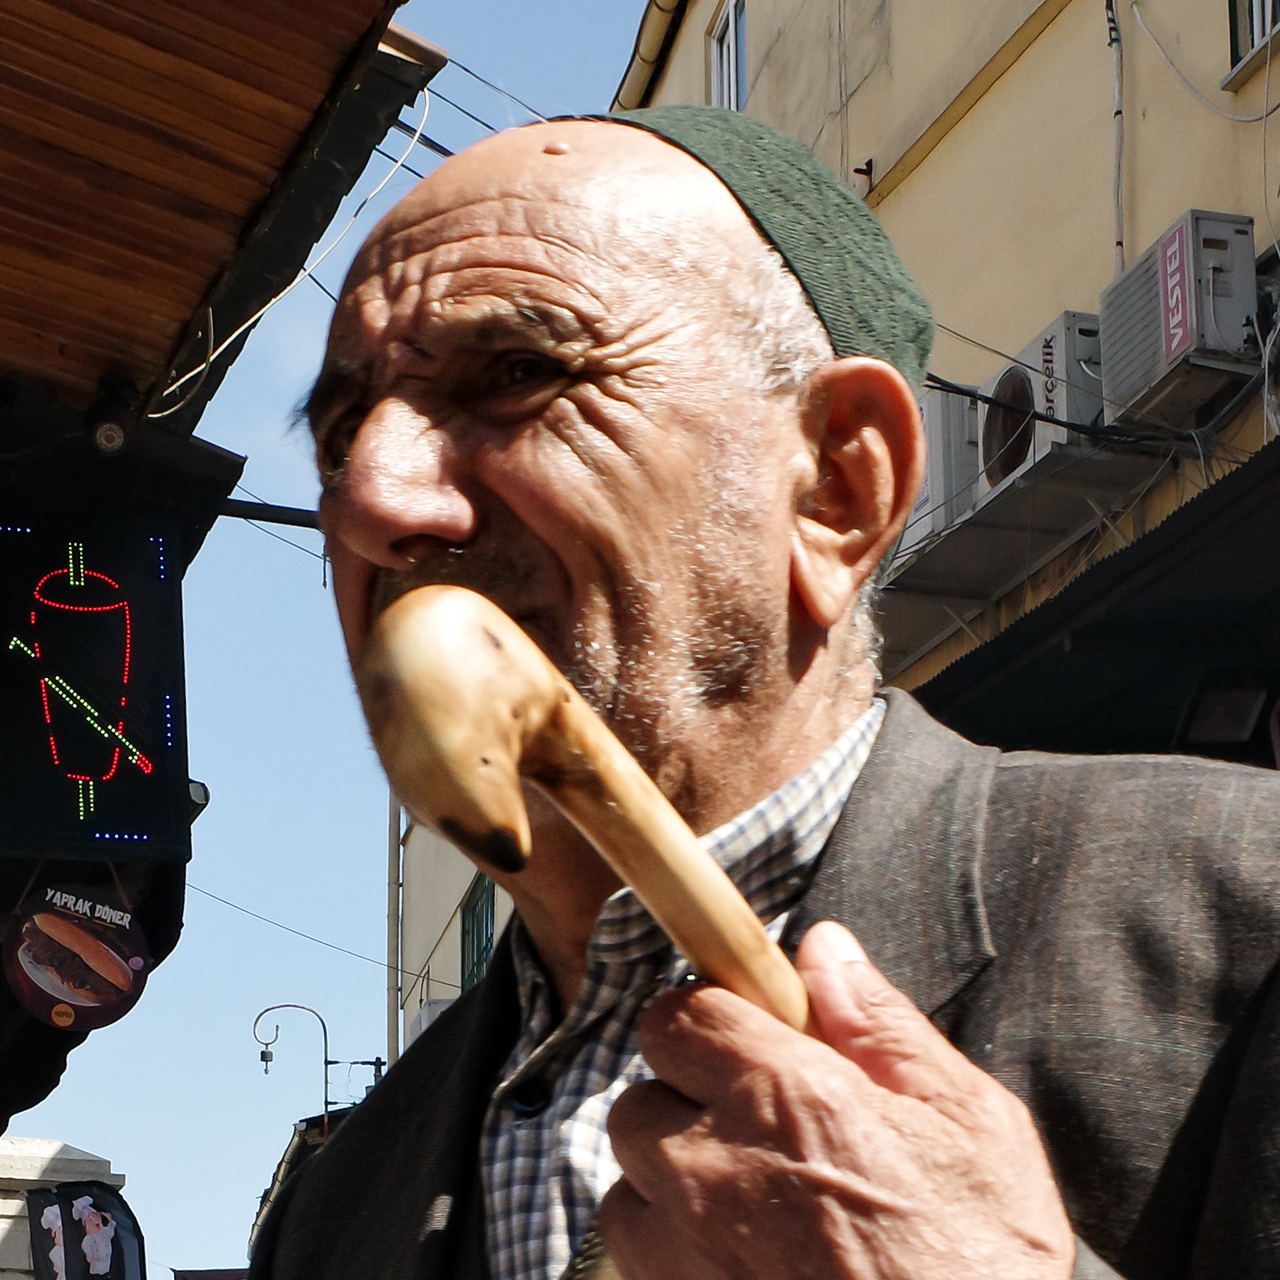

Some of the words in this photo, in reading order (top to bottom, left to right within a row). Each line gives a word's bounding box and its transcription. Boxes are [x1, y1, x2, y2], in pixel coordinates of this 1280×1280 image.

[1165, 231, 1183, 352] VESTEL
[44, 887, 92, 920] YAPRAK
[93, 903, 132, 930] DÖNER
